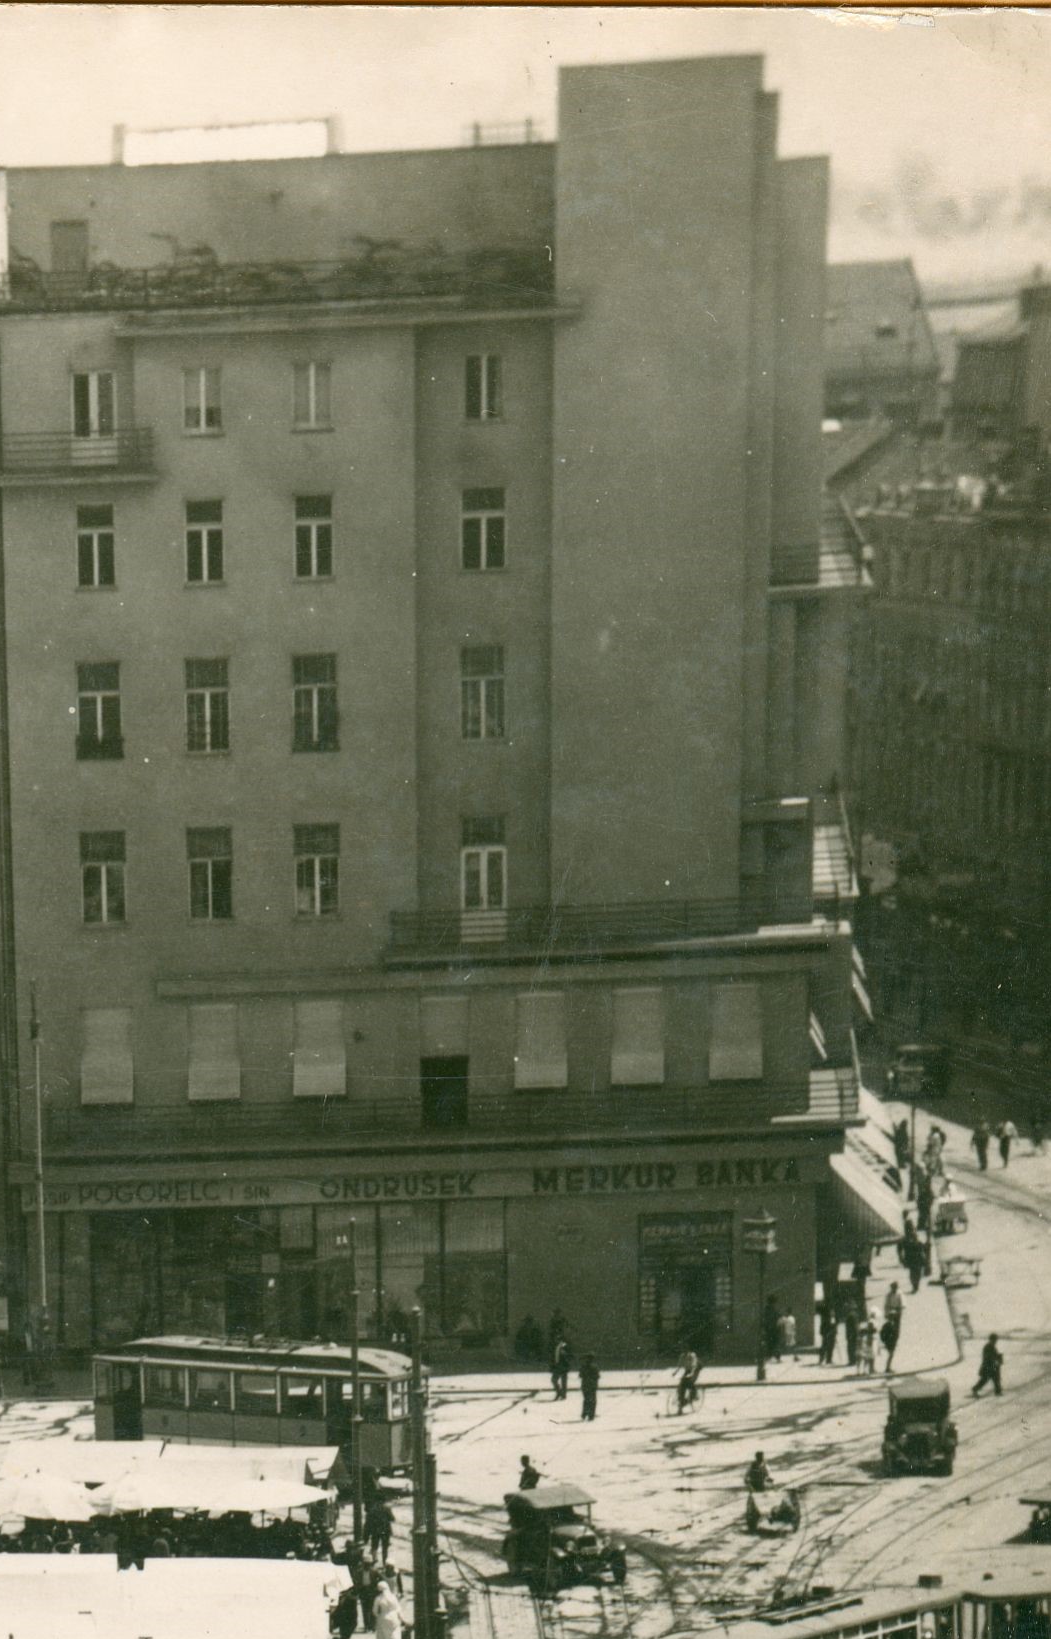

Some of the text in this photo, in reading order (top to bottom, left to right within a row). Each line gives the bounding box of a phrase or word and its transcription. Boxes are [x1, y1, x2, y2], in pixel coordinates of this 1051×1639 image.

[532, 1157, 800, 1192] MERKUR BANKA
[78, 1180, 220, 1205] POGORELC
